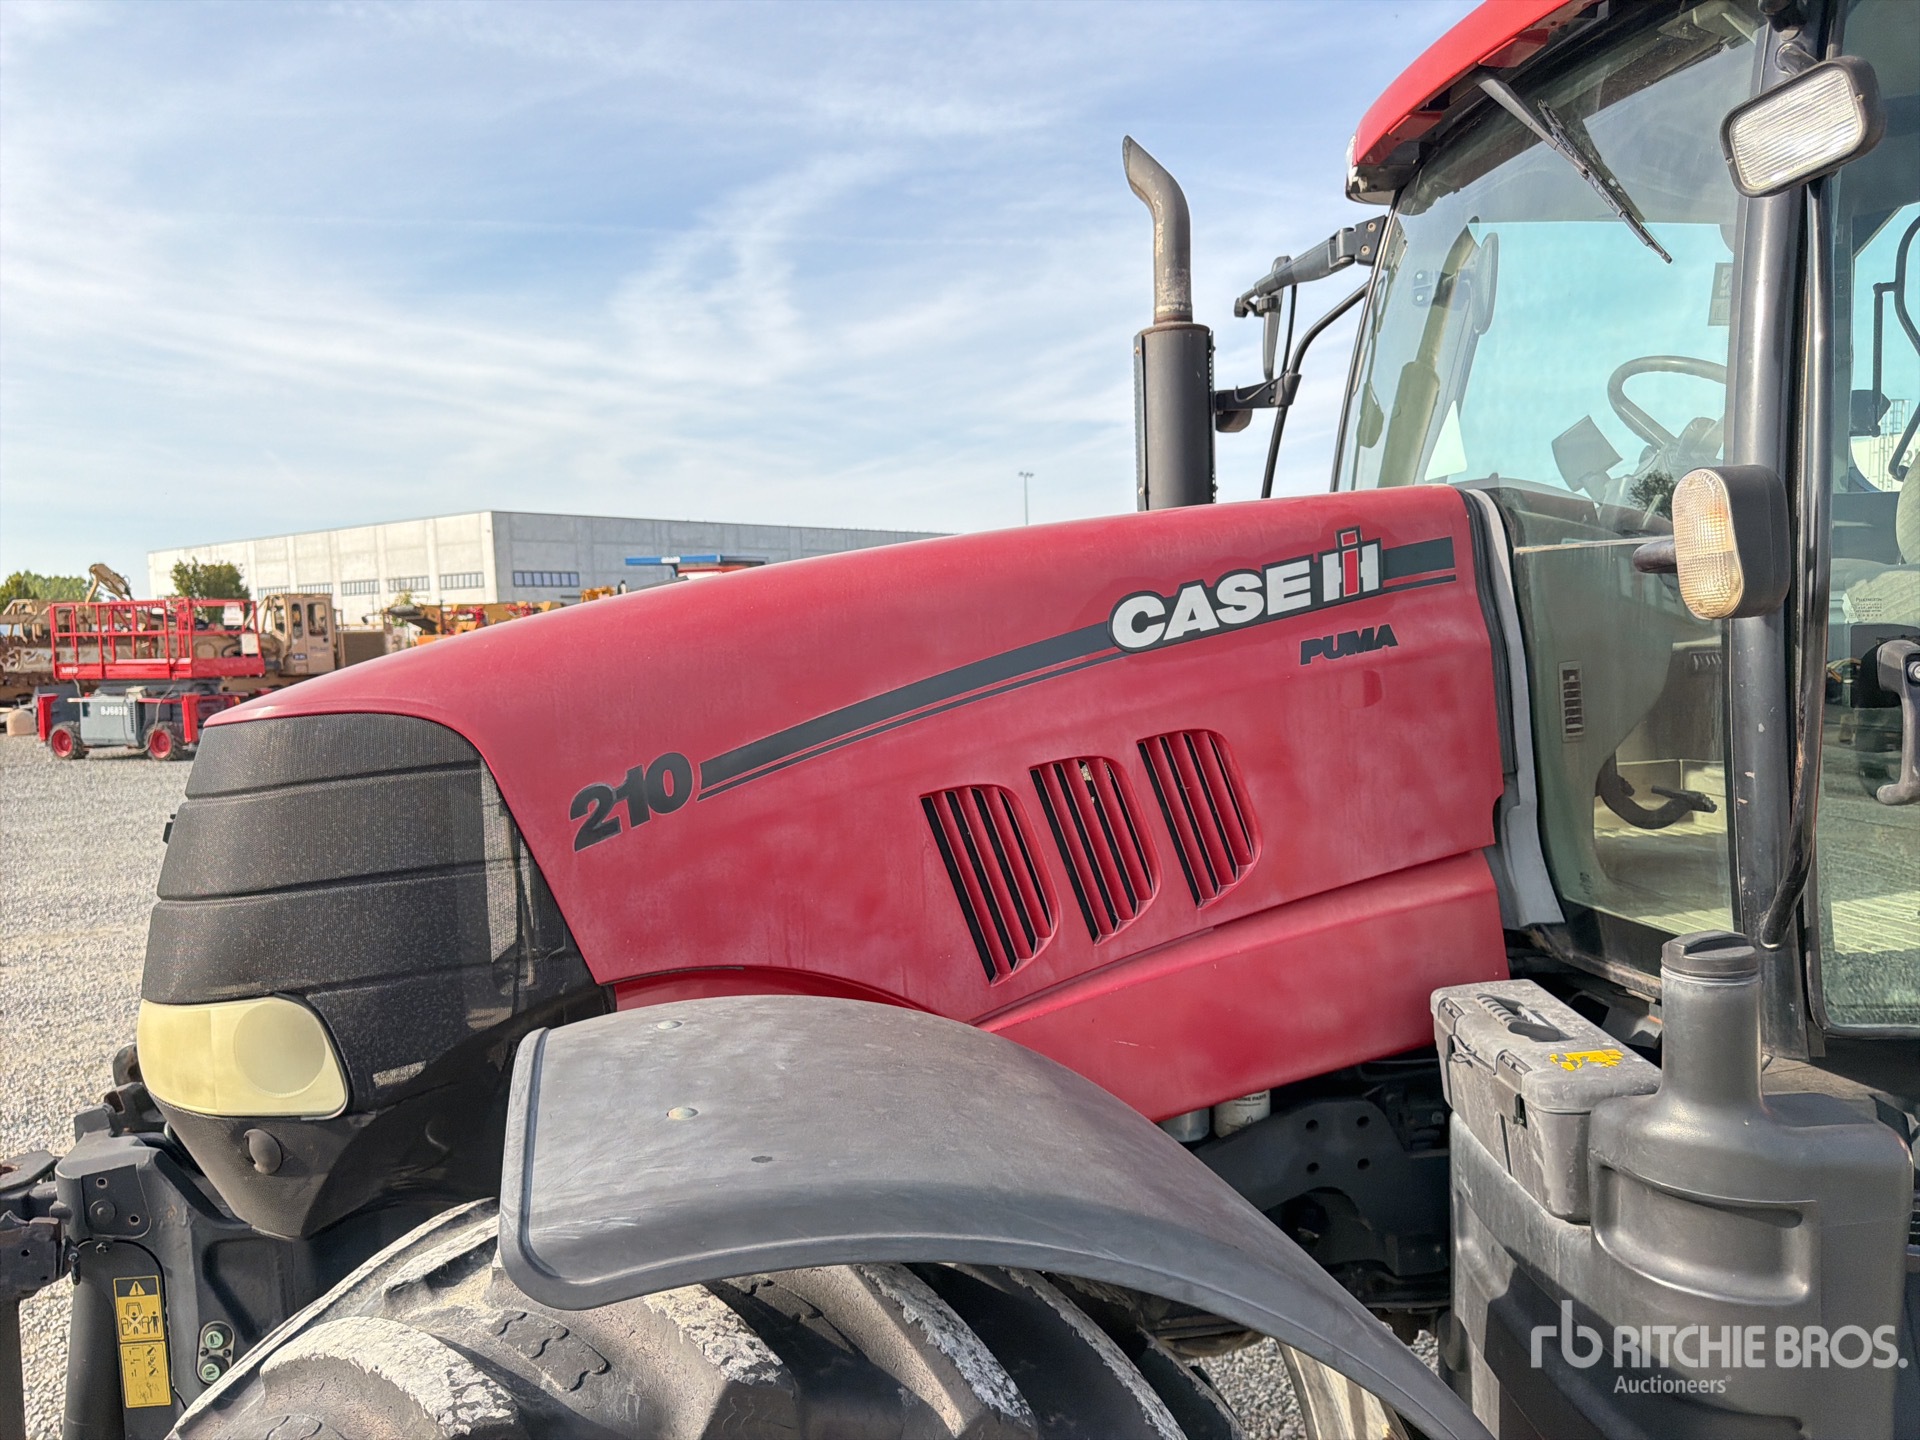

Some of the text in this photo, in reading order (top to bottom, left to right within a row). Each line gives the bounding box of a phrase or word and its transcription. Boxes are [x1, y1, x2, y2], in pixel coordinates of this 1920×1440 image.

[1111, 558, 1312, 649] CASE
[1300, 623, 1398, 666] PUMA
[569, 751, 694, 853] 210
